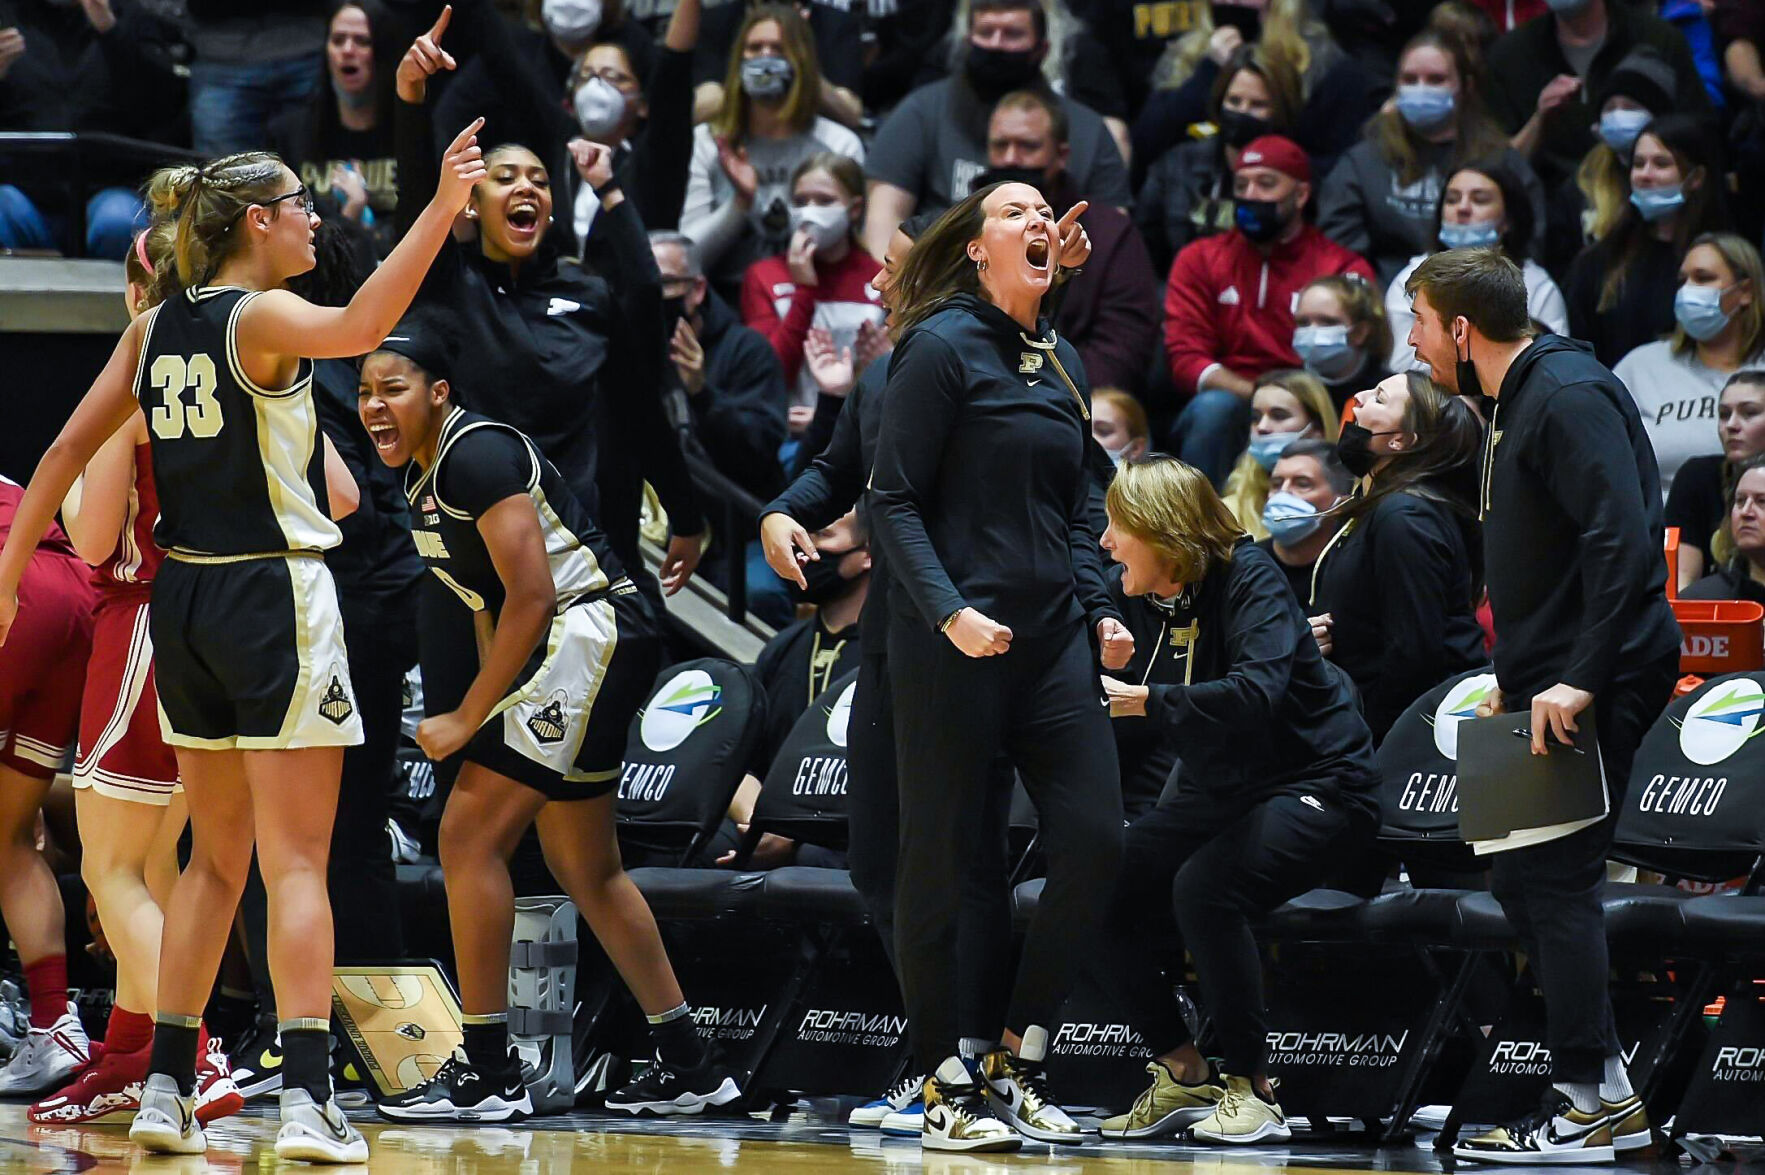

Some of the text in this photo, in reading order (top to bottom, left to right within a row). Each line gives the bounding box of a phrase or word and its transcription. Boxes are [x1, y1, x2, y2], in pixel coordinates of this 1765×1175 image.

[151, 353, 224, 439] 33
[1656, 395, 1715, 425] PUR
[1680, 636, 1728, 656] ADE
[617, 761, 676, 801] EMCO
[1640, 774, 1728, 816] GEMCO
[798, 1009, 908, 1035] ROHRMAN
[797, 1030, 899, 1047] AUTOMOTIVE GROUP
[1052, 1043, 1127, 1057] AUTOMOTIVE
[1268, 1052, 1398, 1067] UTOMOTIVE GROUP
[1489, 1062, 1552, 1076] AUTOMO
[1713, 1068, 1765, 1082] AUTOM
